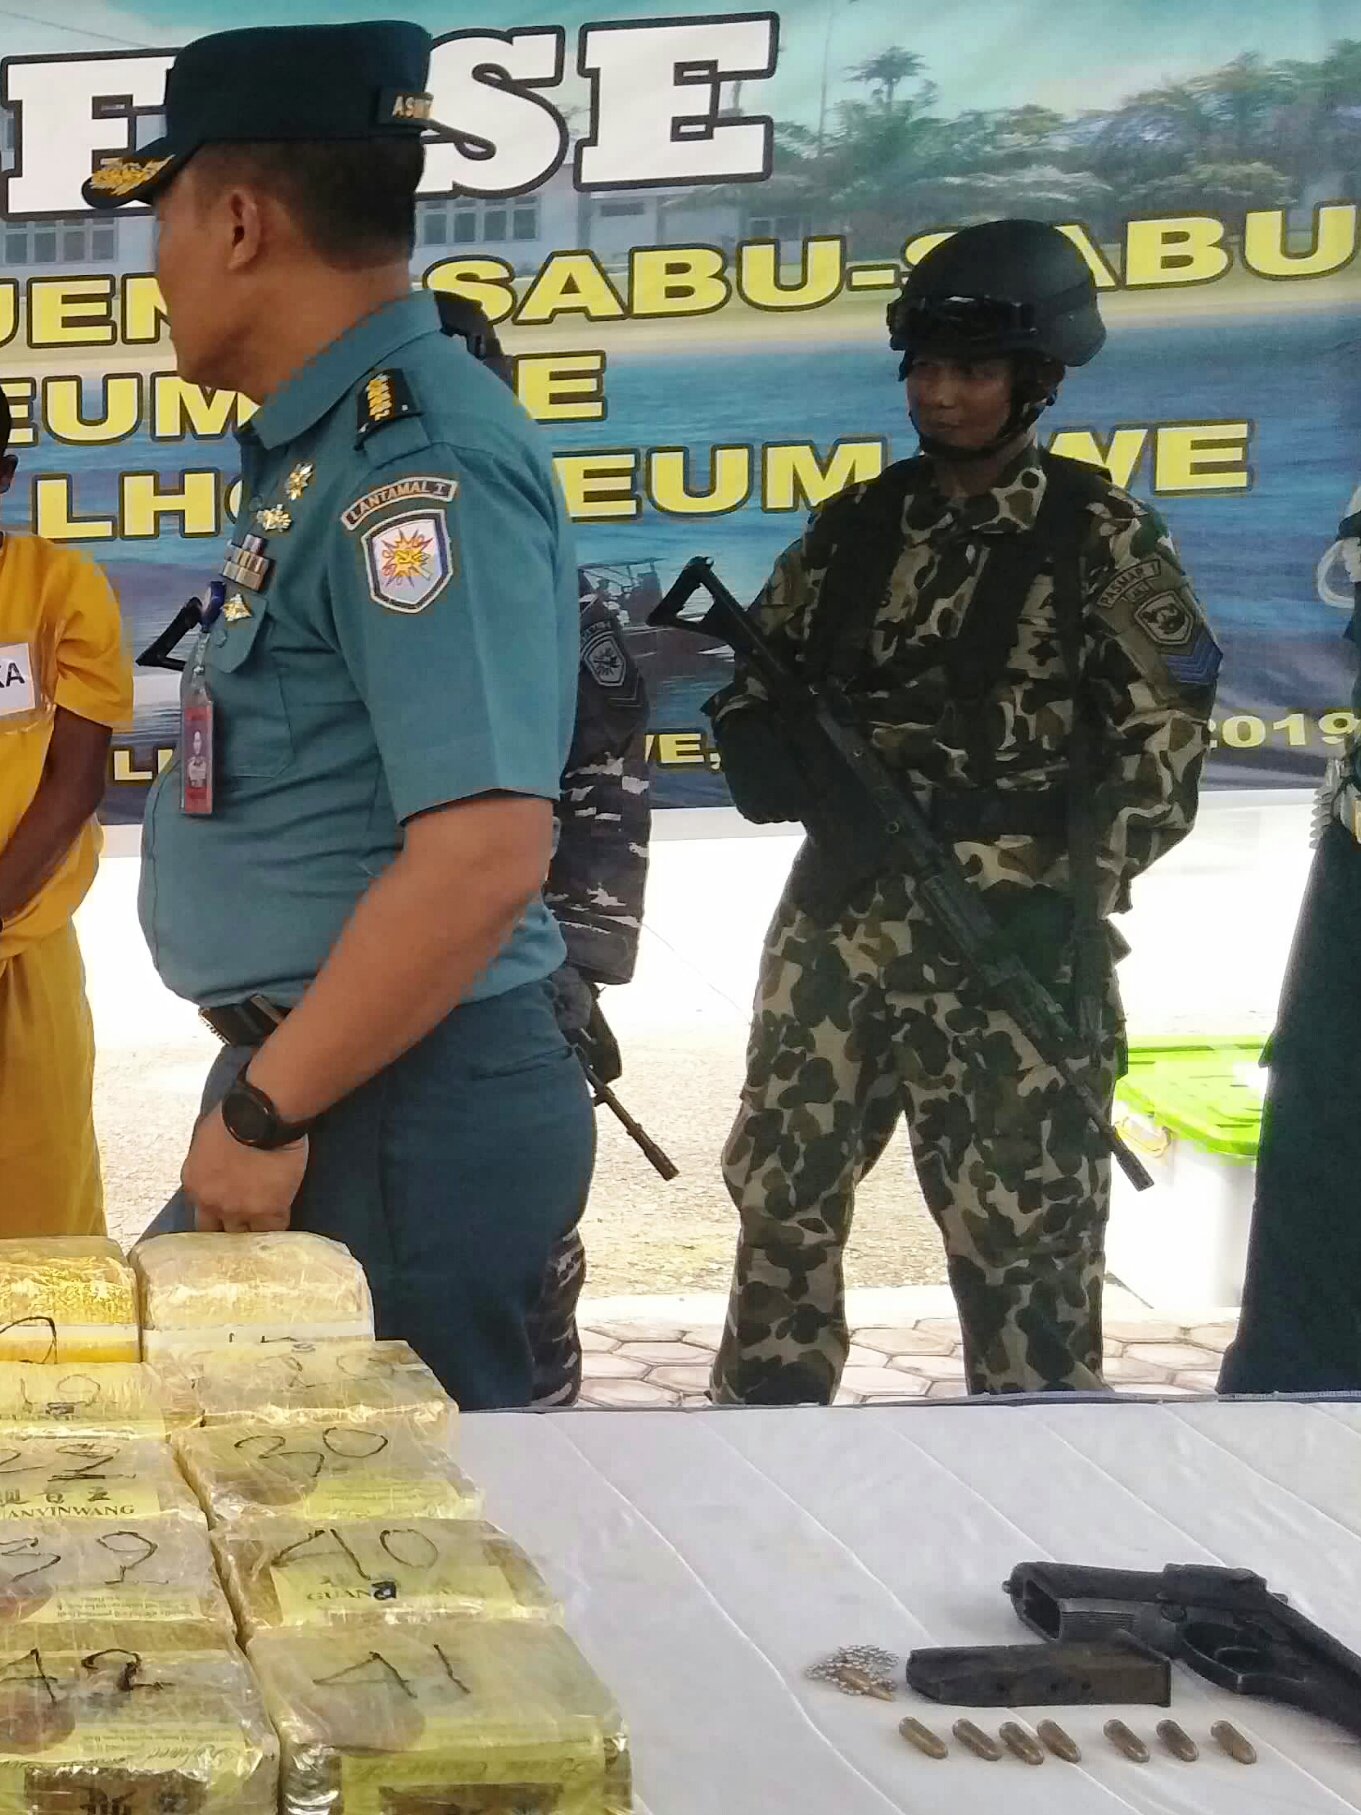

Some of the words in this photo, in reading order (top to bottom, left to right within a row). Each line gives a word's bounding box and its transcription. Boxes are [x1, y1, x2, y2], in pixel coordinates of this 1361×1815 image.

[422, 202, 1360, 326] SABU-BU
[347, 480, 430, 522] LANTAMAL
[1207, 711, 1359, 749] 019
